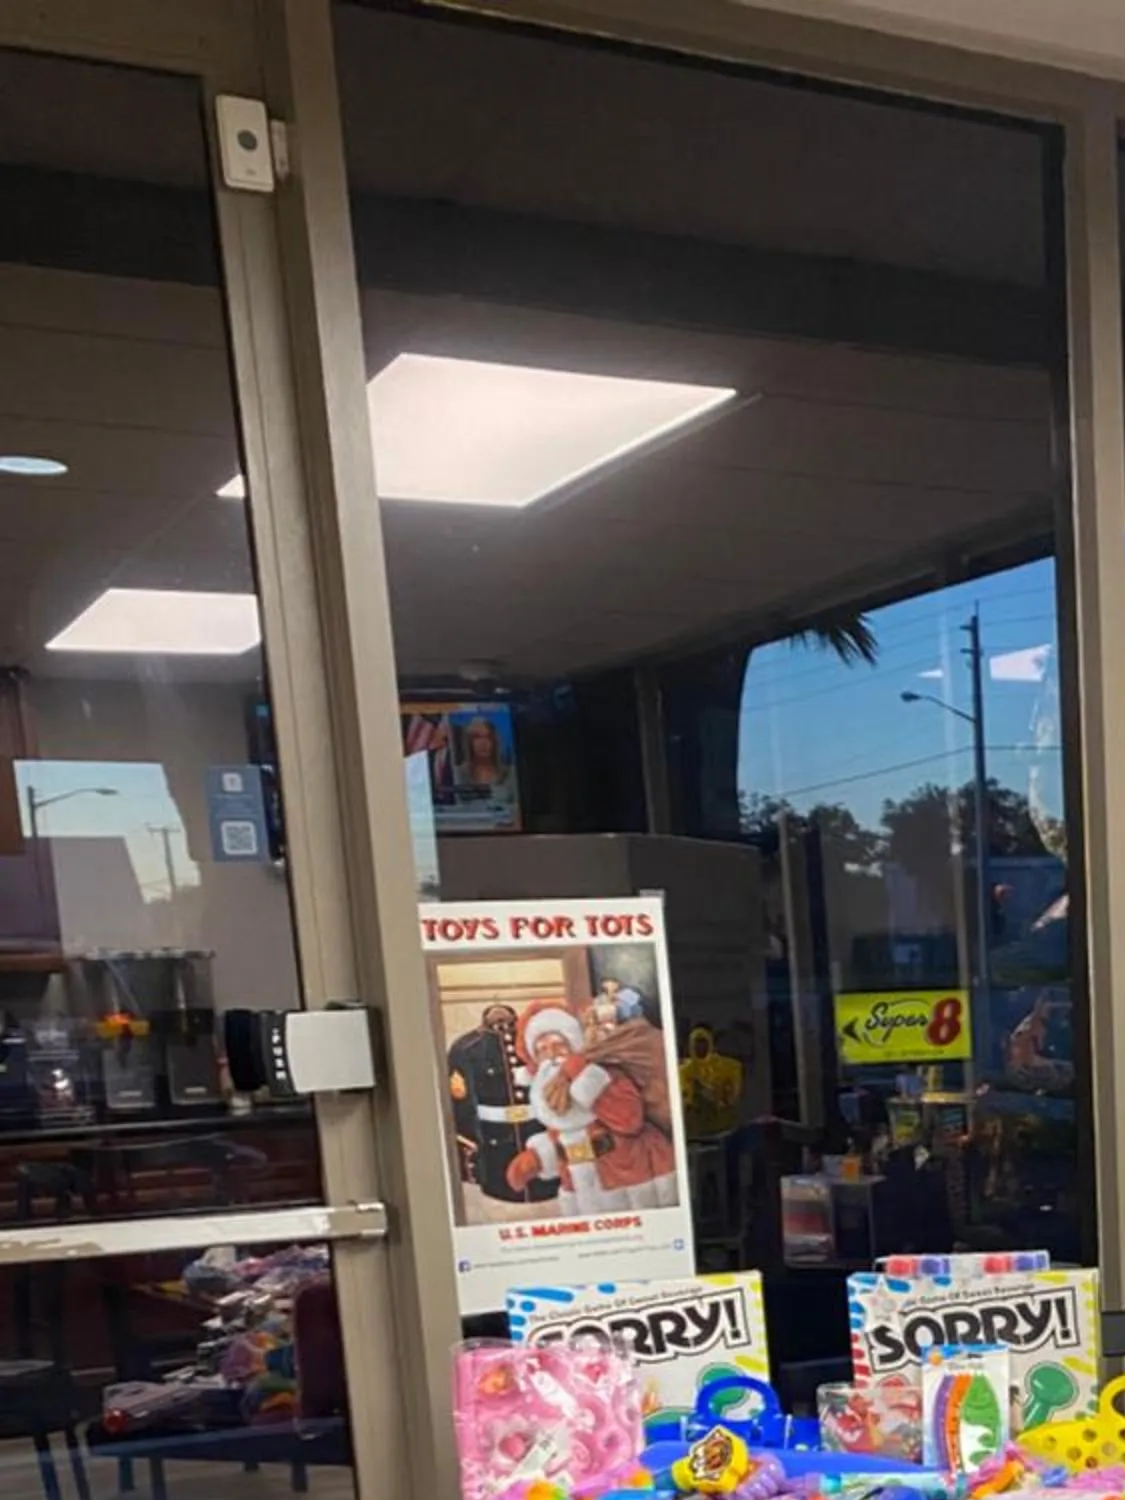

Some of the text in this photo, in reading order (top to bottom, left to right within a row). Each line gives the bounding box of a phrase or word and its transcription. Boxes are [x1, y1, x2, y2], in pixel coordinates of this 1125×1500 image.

[420, 913, 655, 941] TOYS FOR TOTS
[864, 997, 963, 1047] Super 8
[498, 1215, 643, 1242] U.S. MARINE CORPS
[872, 1296, 1071, 1364] SORRY!
